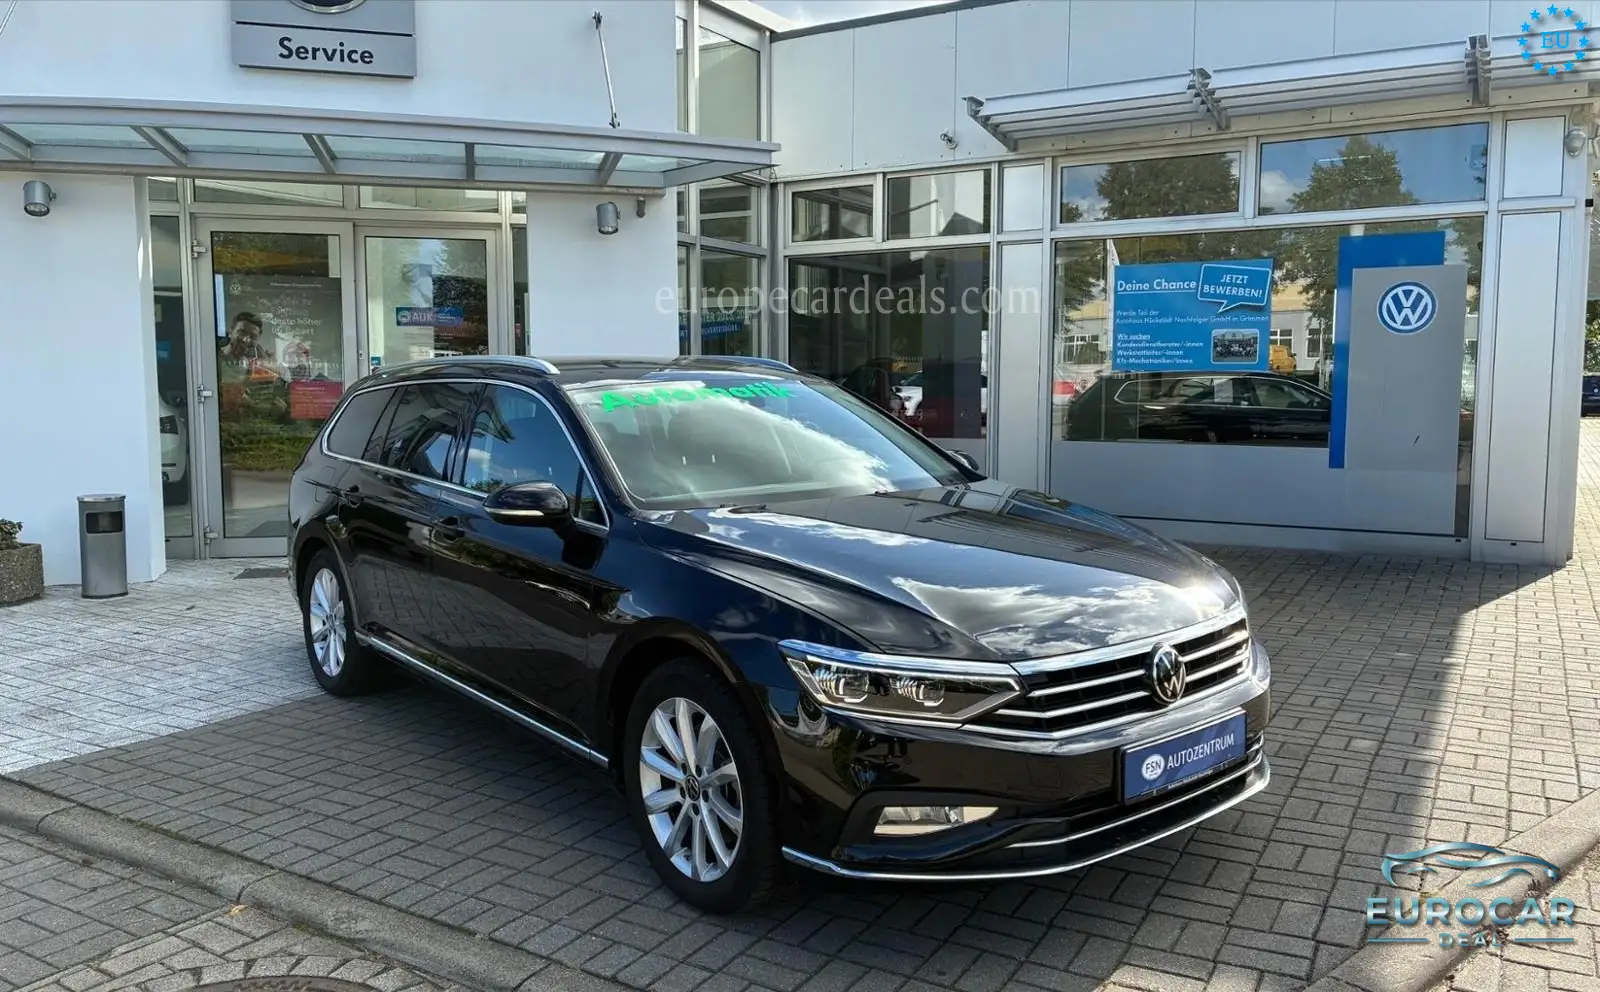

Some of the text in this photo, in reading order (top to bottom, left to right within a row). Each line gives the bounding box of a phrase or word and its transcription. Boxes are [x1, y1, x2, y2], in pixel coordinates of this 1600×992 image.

[278, 36, 374, 65] Service
[1117, 279, 1197, 292] Deine Chance
[1220, 274, 1249, 284] JETZT
[1202, 284, 1263, 298] BEWERBEN!
[602, 381, 790, 413] Automatik
[1145, 732, 1235, 775] FSN AUTOZENTRUM
